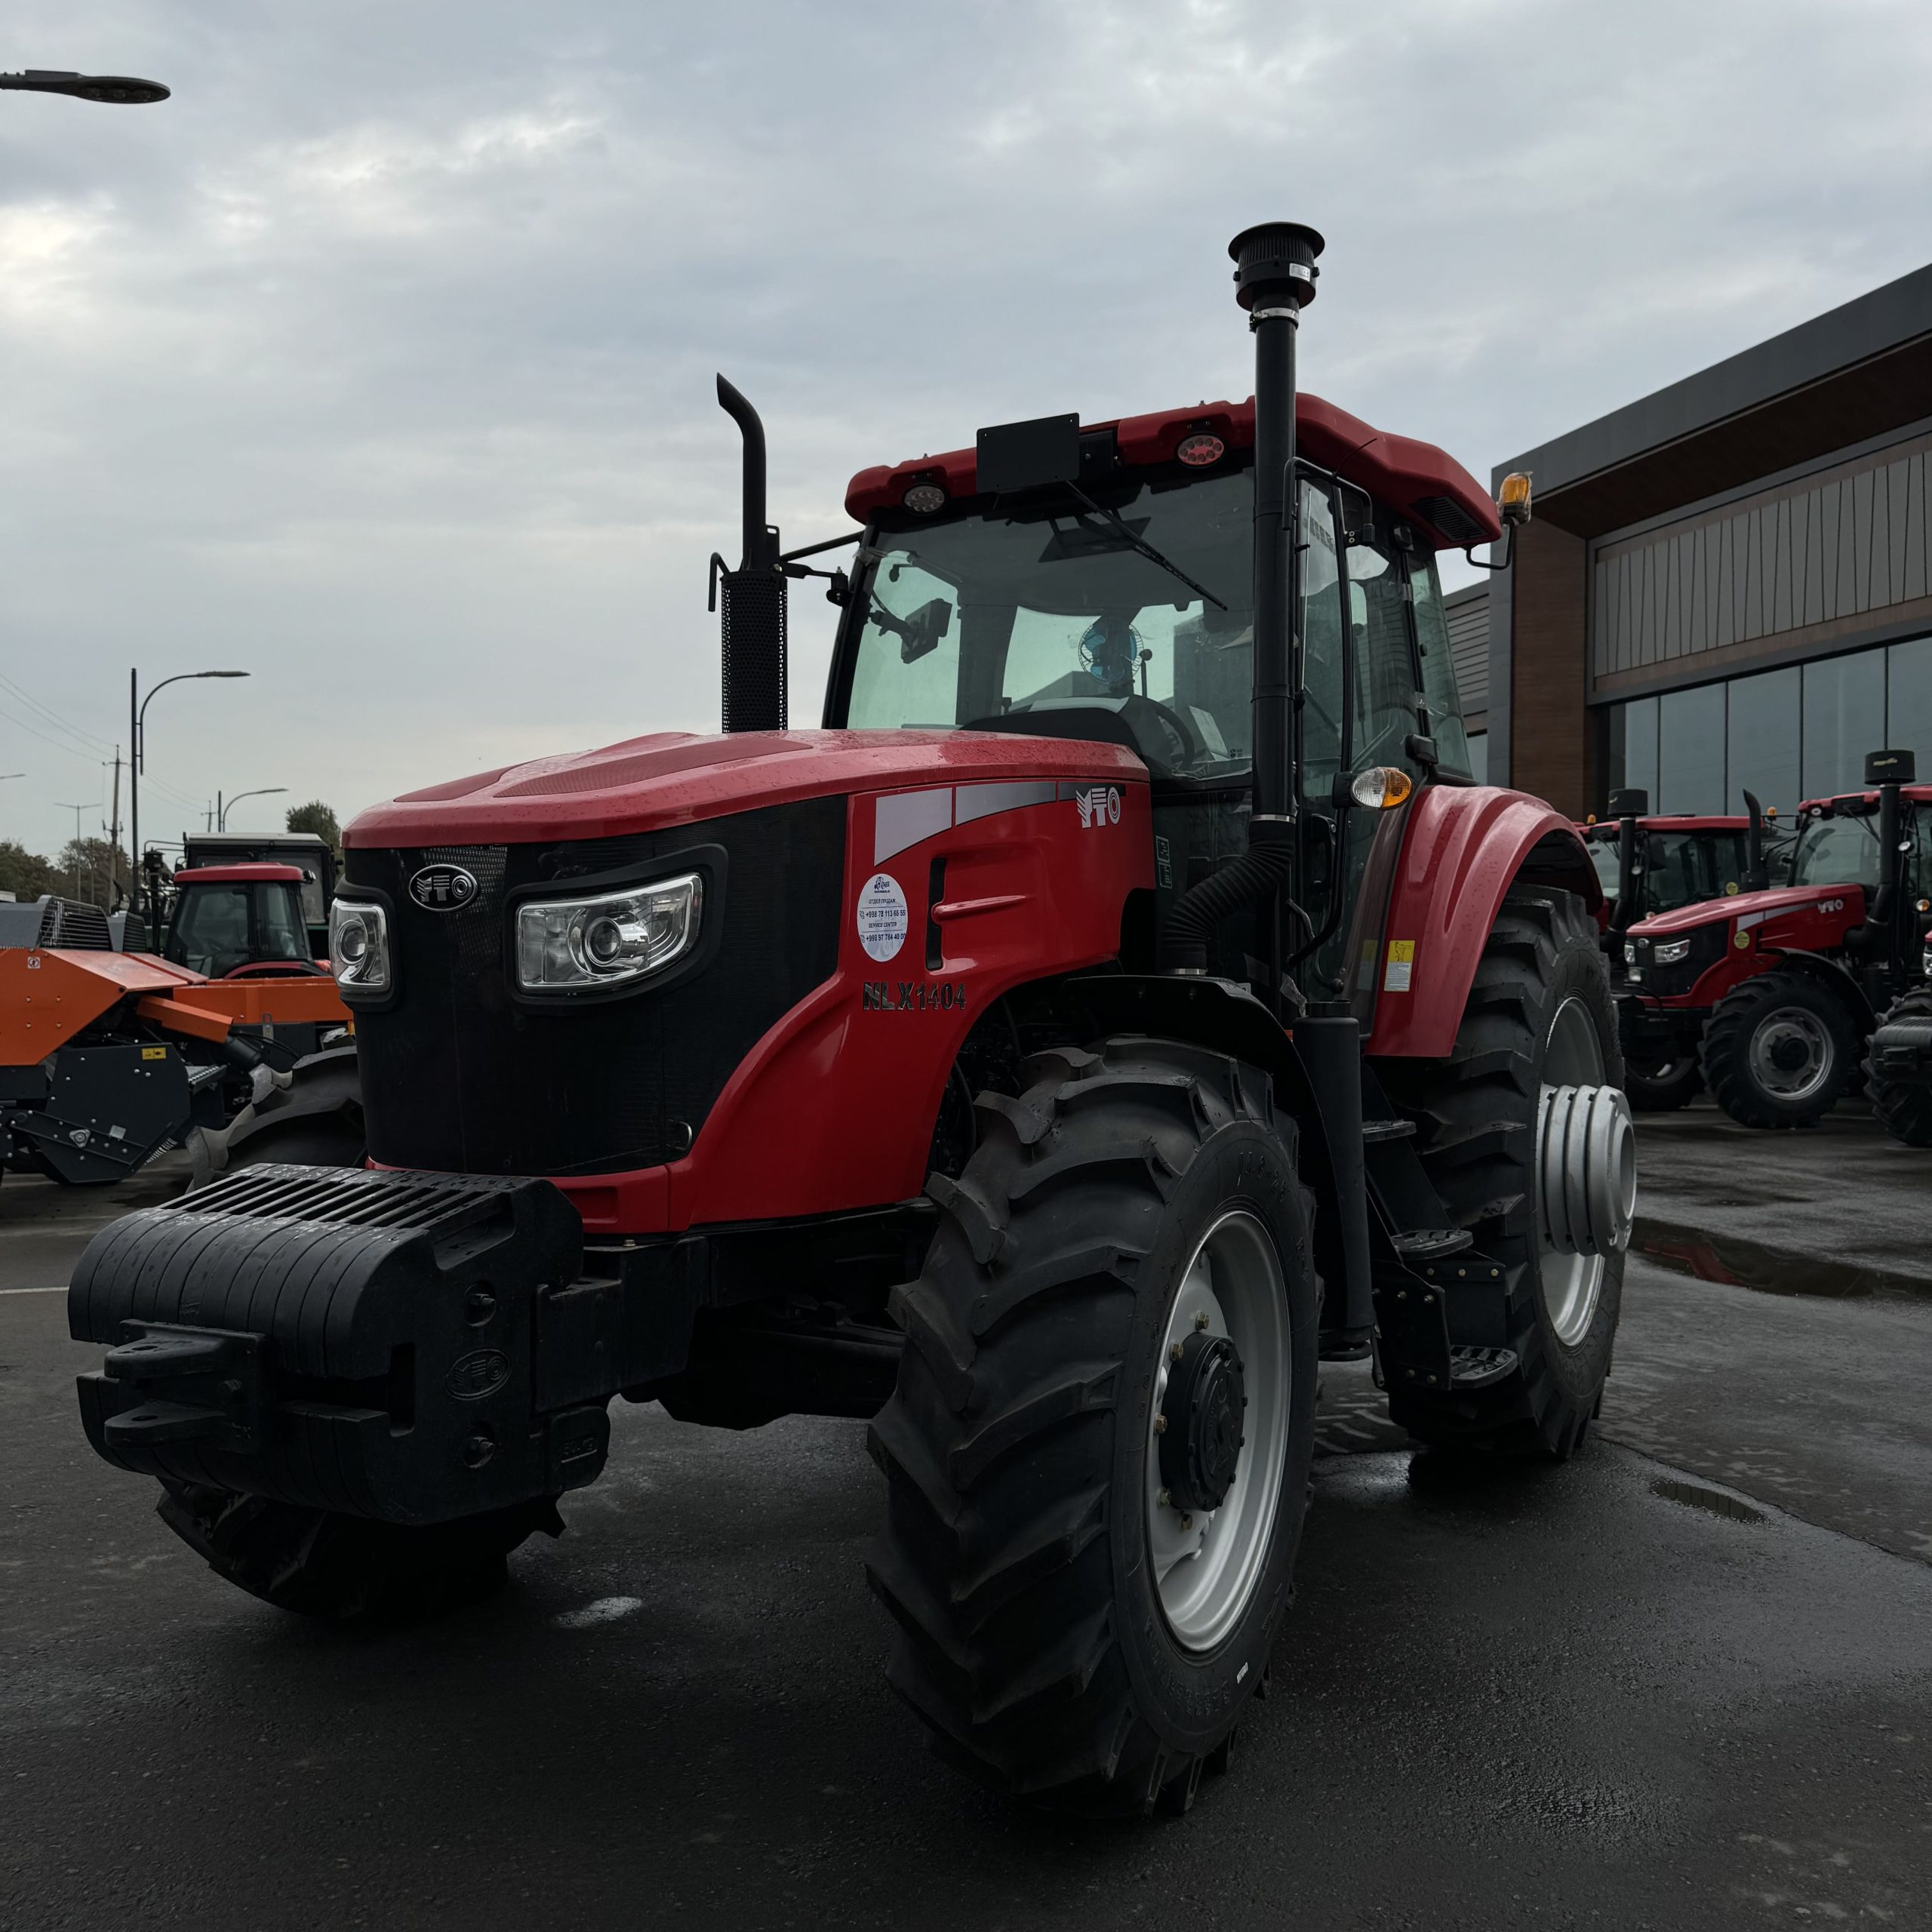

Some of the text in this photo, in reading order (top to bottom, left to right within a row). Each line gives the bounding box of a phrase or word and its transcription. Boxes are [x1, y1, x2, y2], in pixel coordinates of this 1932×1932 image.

[1075, 787, 1121, 829] YTO
[417, 875, 472, 903] YTO
[863, 982, 966, 1011] NLX1404
